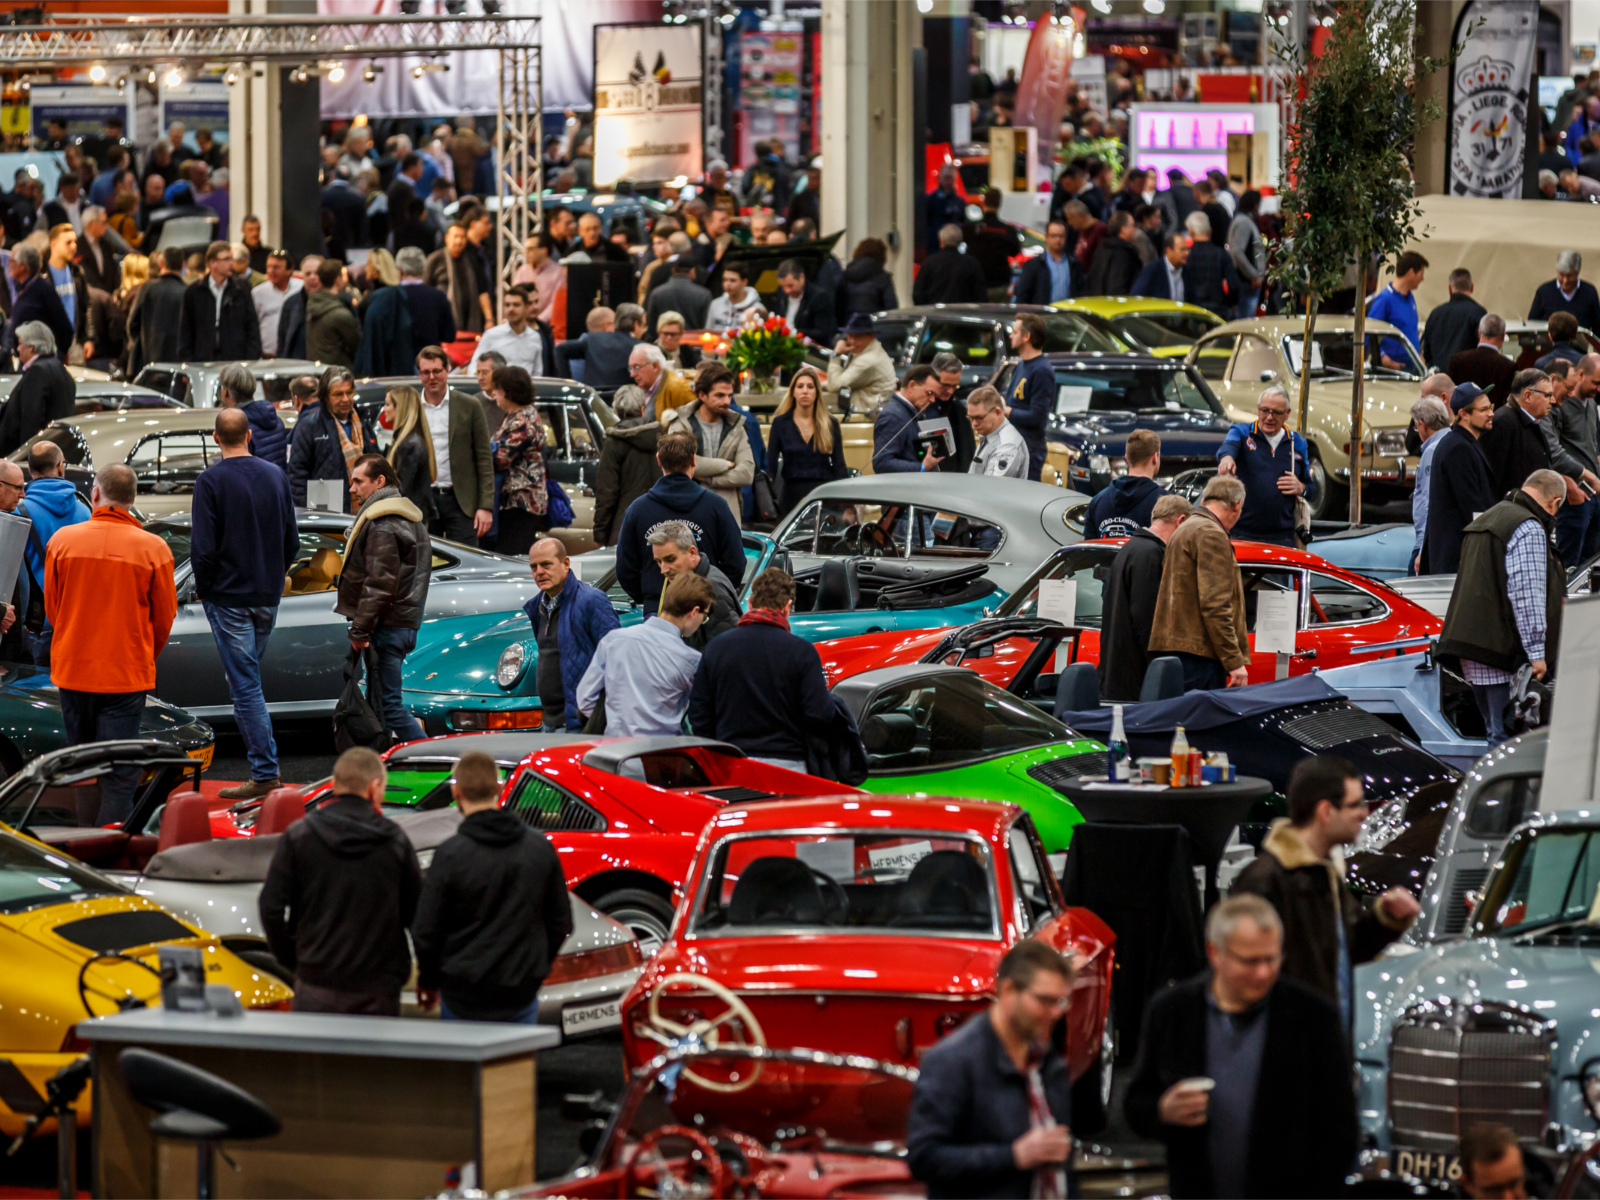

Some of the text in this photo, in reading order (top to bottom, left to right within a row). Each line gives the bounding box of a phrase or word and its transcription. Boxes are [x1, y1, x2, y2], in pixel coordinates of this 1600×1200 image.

[1472, 95, 1508, 112] LIEGE
[1453, 159, 1474, 182] SPA
[1013, 377, 1027, 400] A
